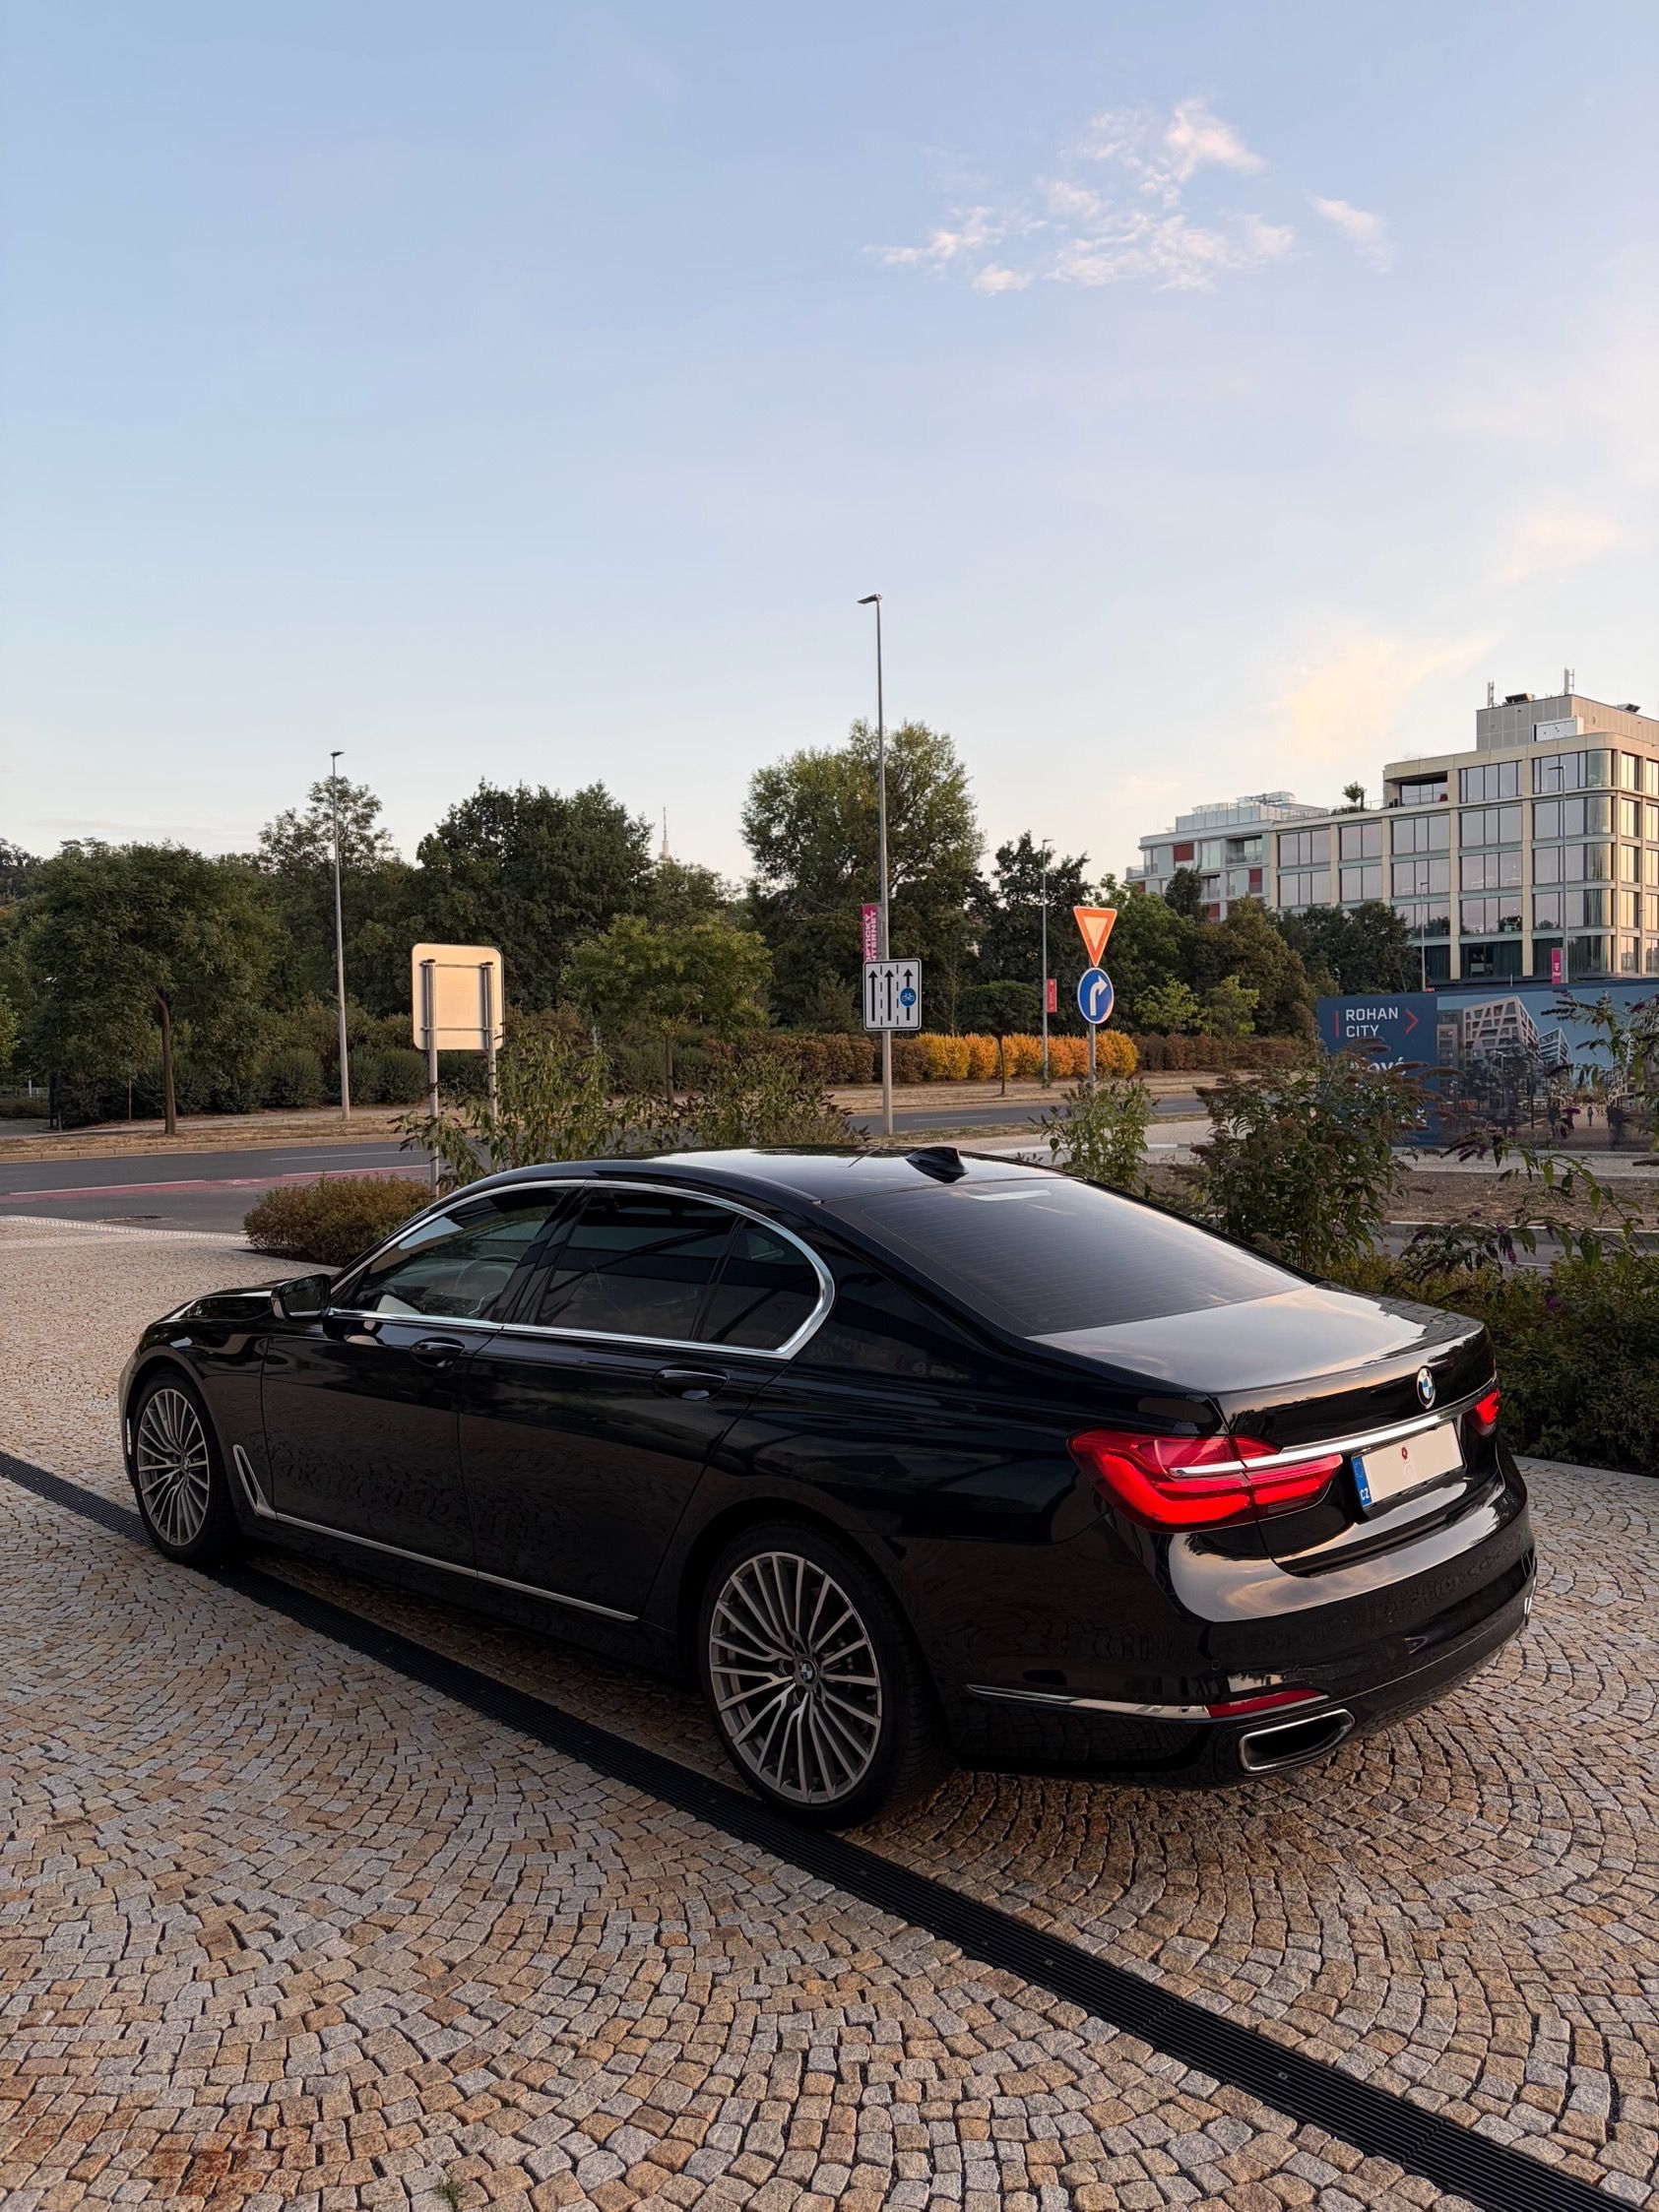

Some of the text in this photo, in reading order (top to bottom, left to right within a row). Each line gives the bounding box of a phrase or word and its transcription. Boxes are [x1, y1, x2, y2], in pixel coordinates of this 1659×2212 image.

[1345, 1007, 1398, 1022] ROHAN
[1345, 1025, 1379, 1038] CITY
[1360, 1487, 1371, 1501] CZ
